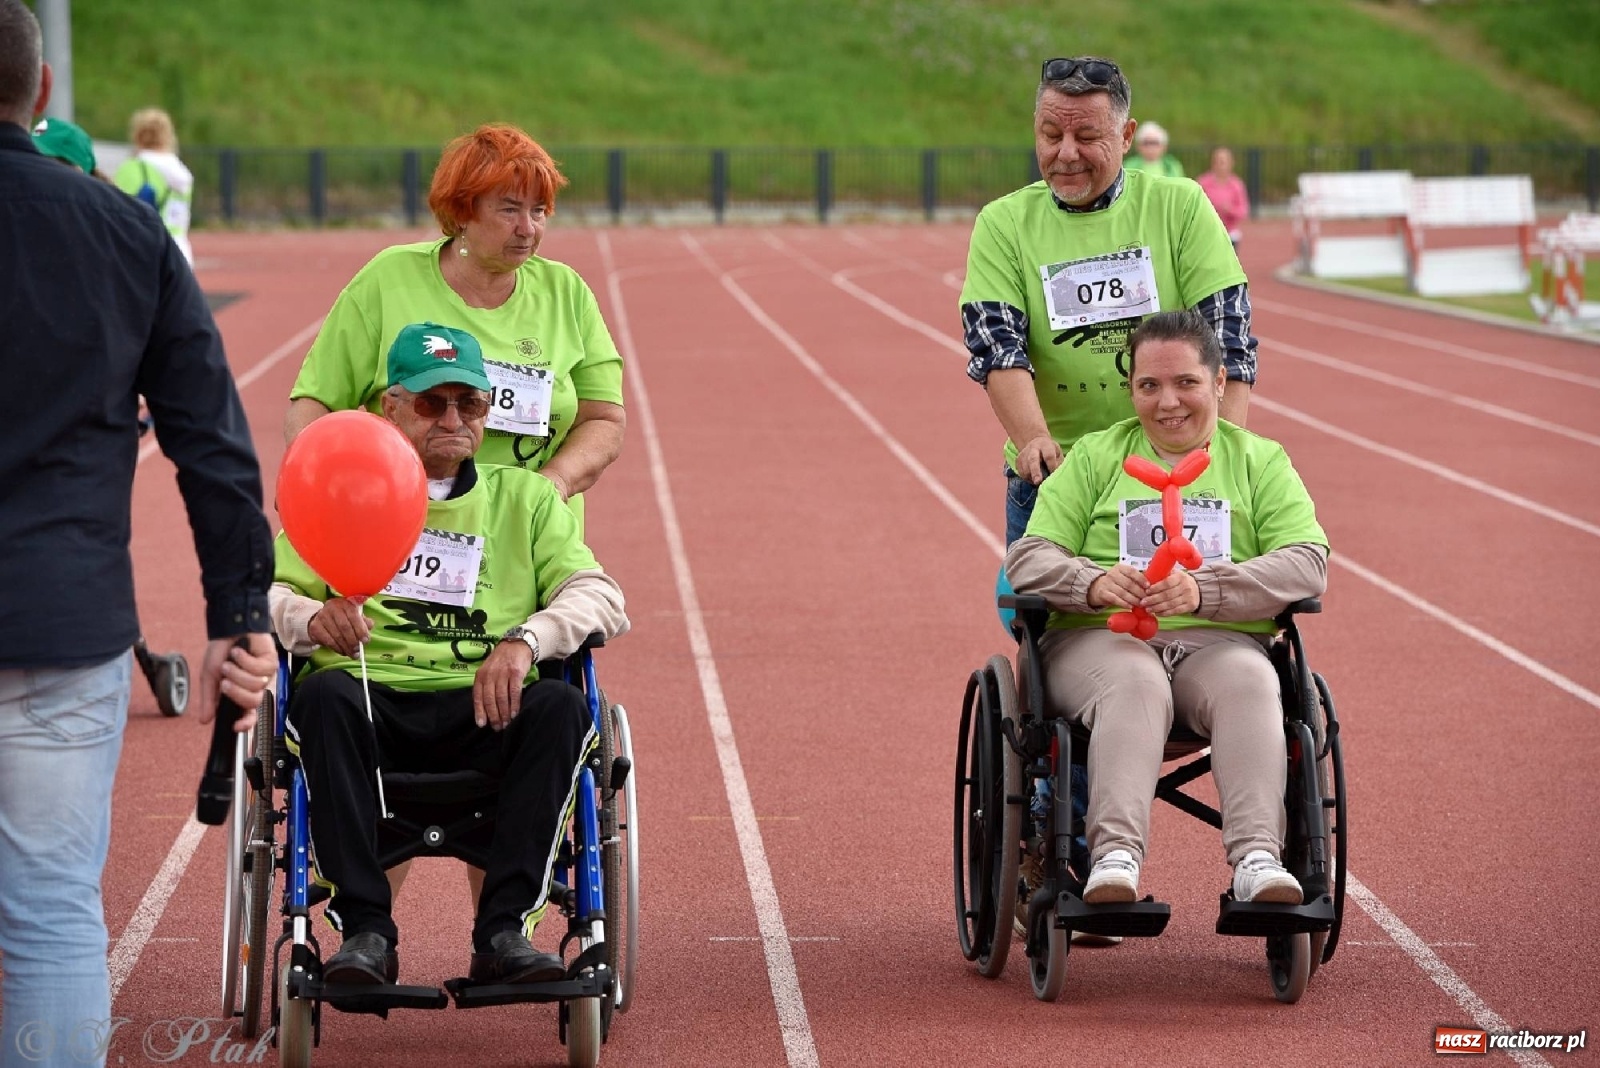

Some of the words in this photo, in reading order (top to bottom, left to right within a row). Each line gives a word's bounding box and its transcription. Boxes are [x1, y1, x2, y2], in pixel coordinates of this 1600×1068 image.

[1077, 278, 1124, 305] 078
[490, 385, 515, 410] 18
[1150, 525, 1199, 547] 07
[425, 611, 456, 629] VII
